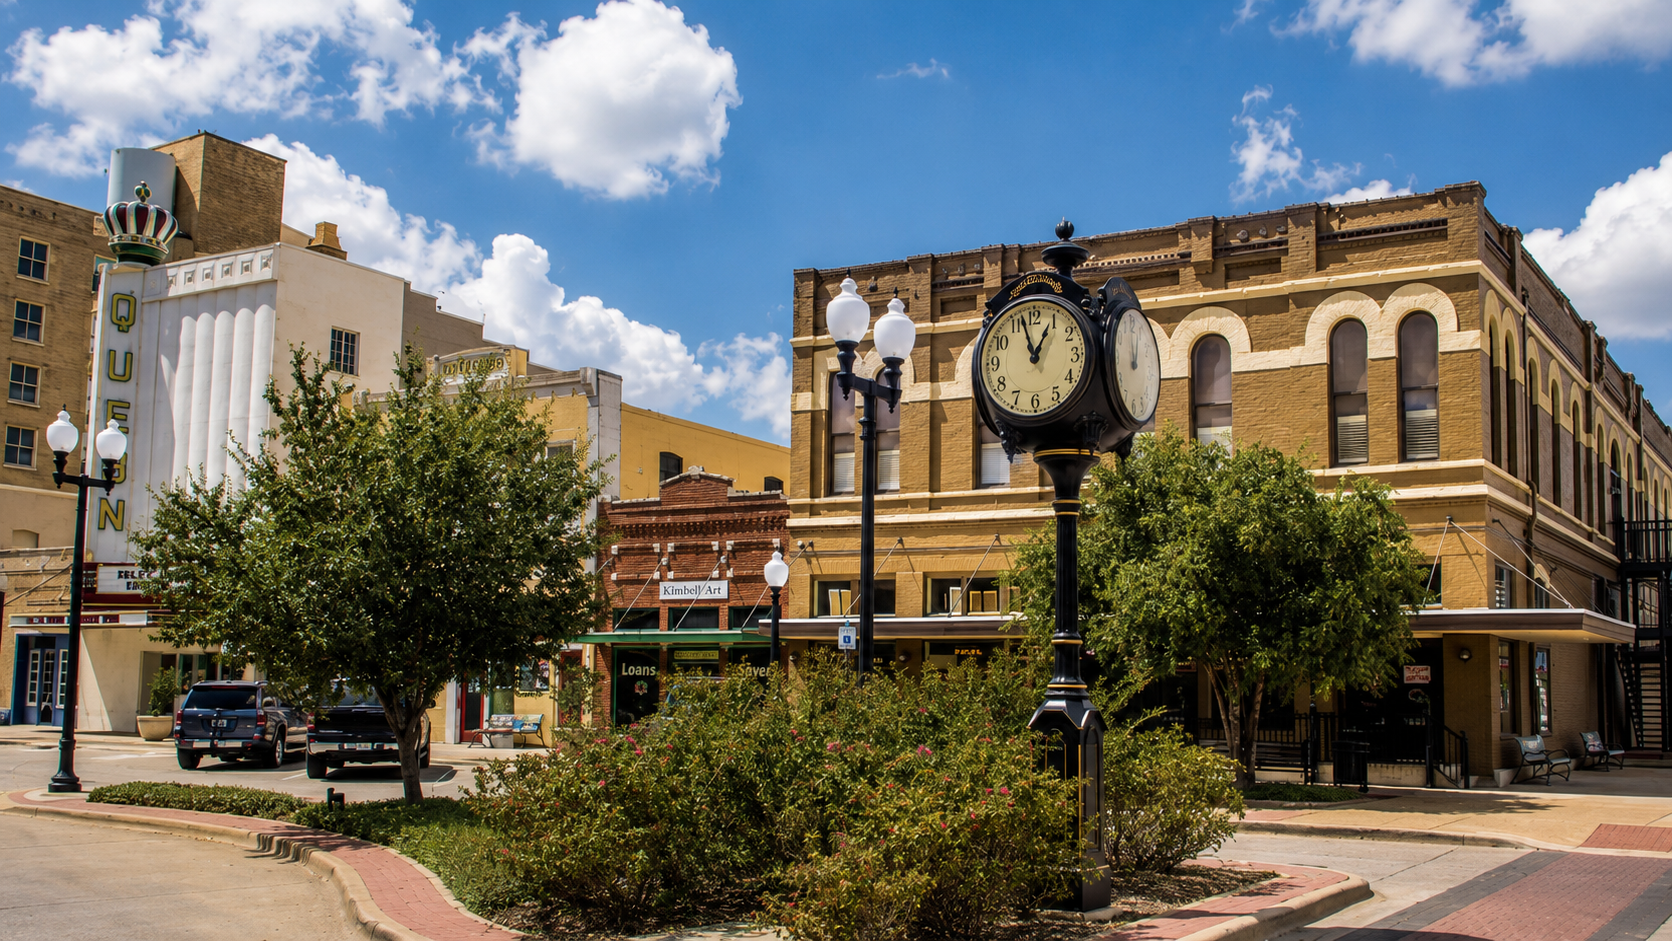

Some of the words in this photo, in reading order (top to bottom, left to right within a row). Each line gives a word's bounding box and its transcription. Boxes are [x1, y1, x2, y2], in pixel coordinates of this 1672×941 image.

[1011, 318, 1020, 333] 11
[1028, 310, 1041, 326] 12
[1051, 313, 1057, 329] 1
[1064, 326, 1074, 342] 2
[996, 334, 1009, 351] 10
[1070, 346, 1080, 363] 3
[990, 355, 1000, 372] 9
[997, 376, 1006, 391] 8
[1064, 368, 1074, 384] 4
[1011, 389, 1021, 405] 7
[1030, 393, 1040, 409] 6
[1051, 385, 1060, 402] 5
[663, 584, 701, 596] Kimbell
[704, 585, 722, 595] Art
[621, 662, 657, 677] Loans
